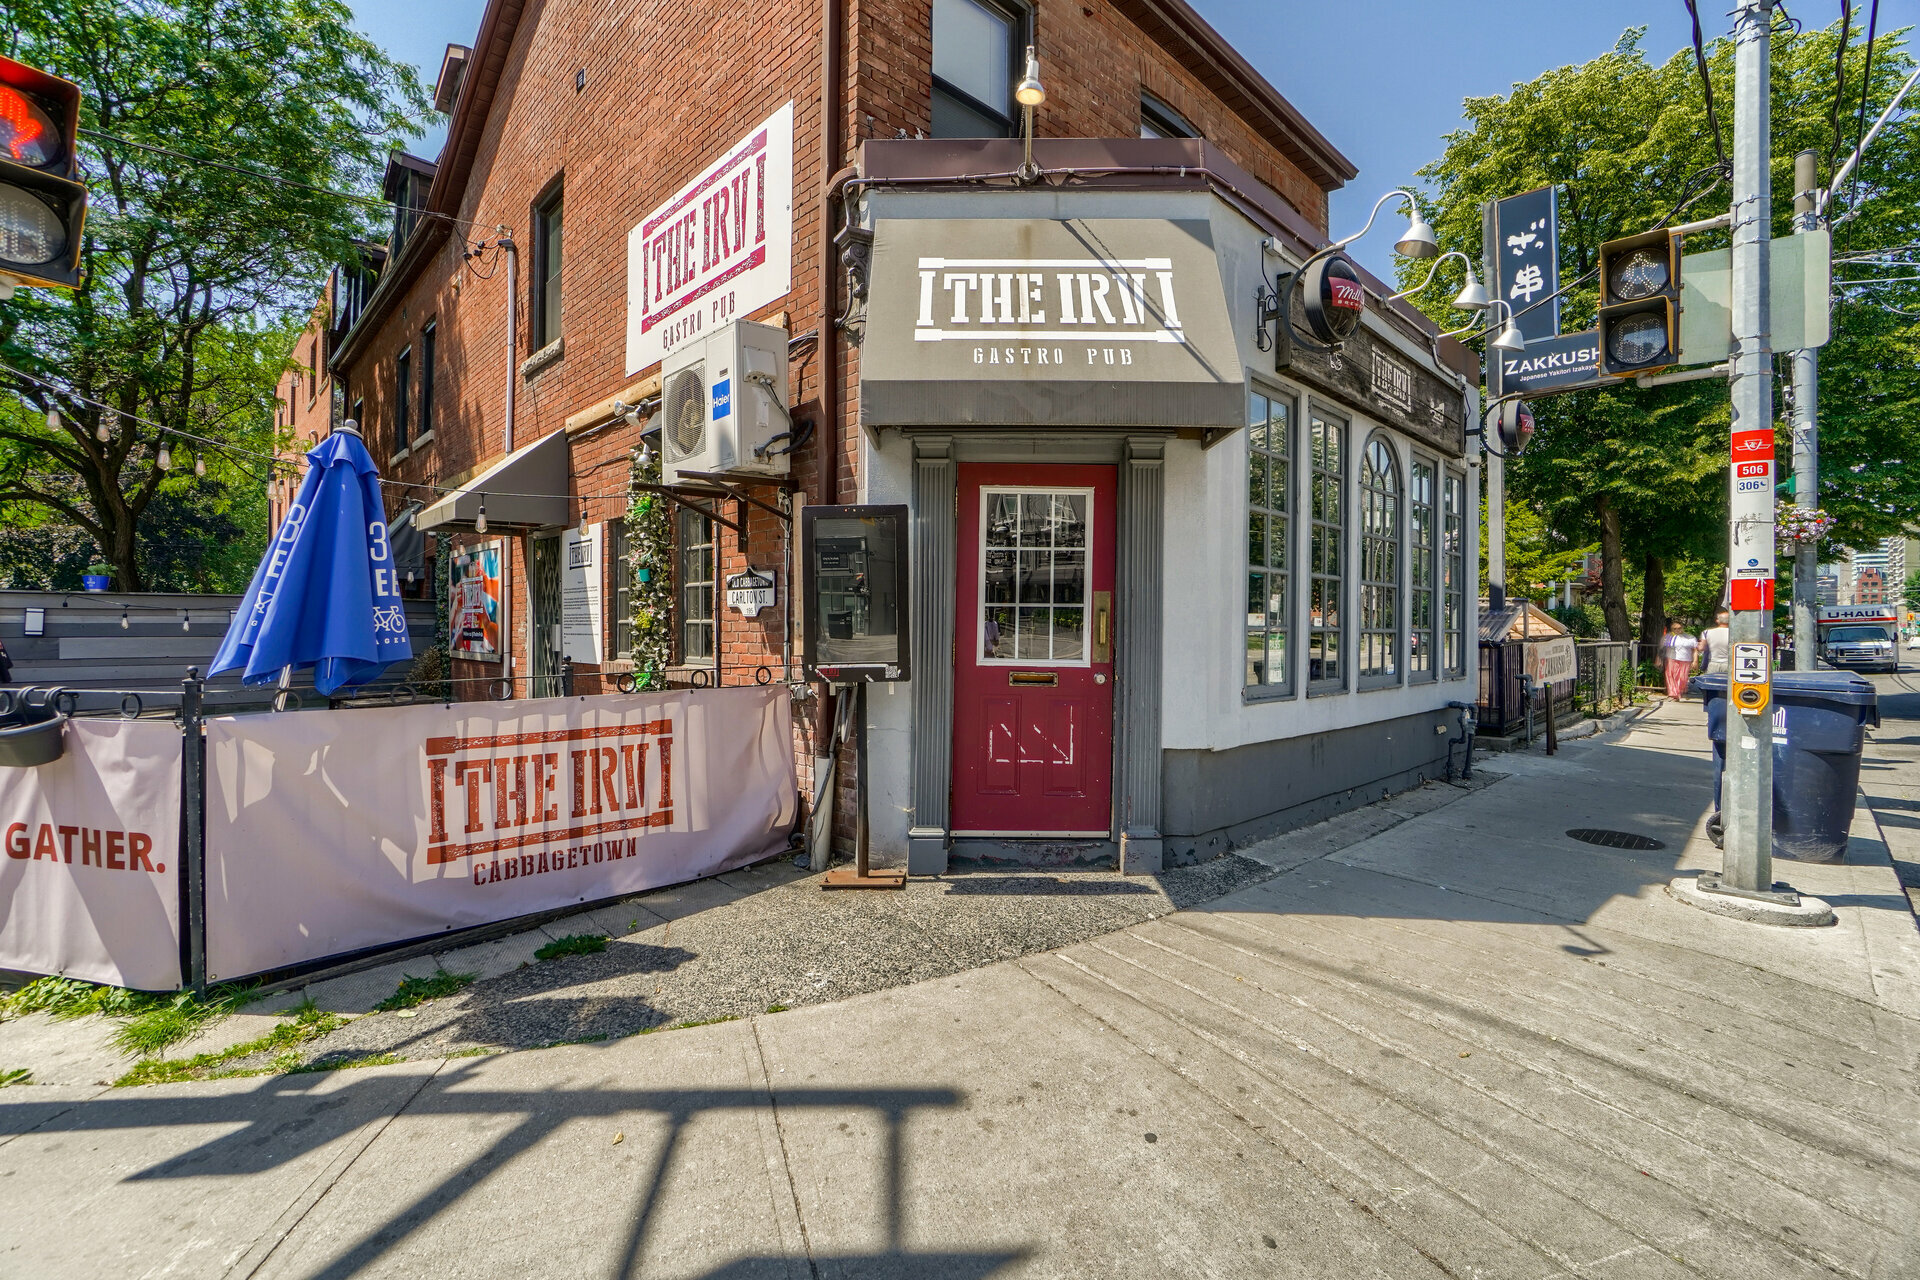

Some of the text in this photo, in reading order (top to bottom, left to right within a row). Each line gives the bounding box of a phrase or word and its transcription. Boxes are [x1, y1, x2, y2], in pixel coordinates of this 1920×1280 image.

[1335, 285, 1361, 302] Mill
[663, 290, 736, 350] GASTRO PUB
[973, 347, 1133, 365] GASTRO PUB
[1504, 347, 1600, 376] ZAKKUSH
[1520, 363, 1597, 382] Japanese Yakitori Izakaya
[713, 394, 730, 409] Haier
[1742, 465, 1764, 475] 506
[1739, 481, 1760, 491] 306
[732, 590, 768, 604] CARLTON ST.
[5, 822, 166, 874] GATHER.
[473, 836, 638, 887] CABBAGETOWN
